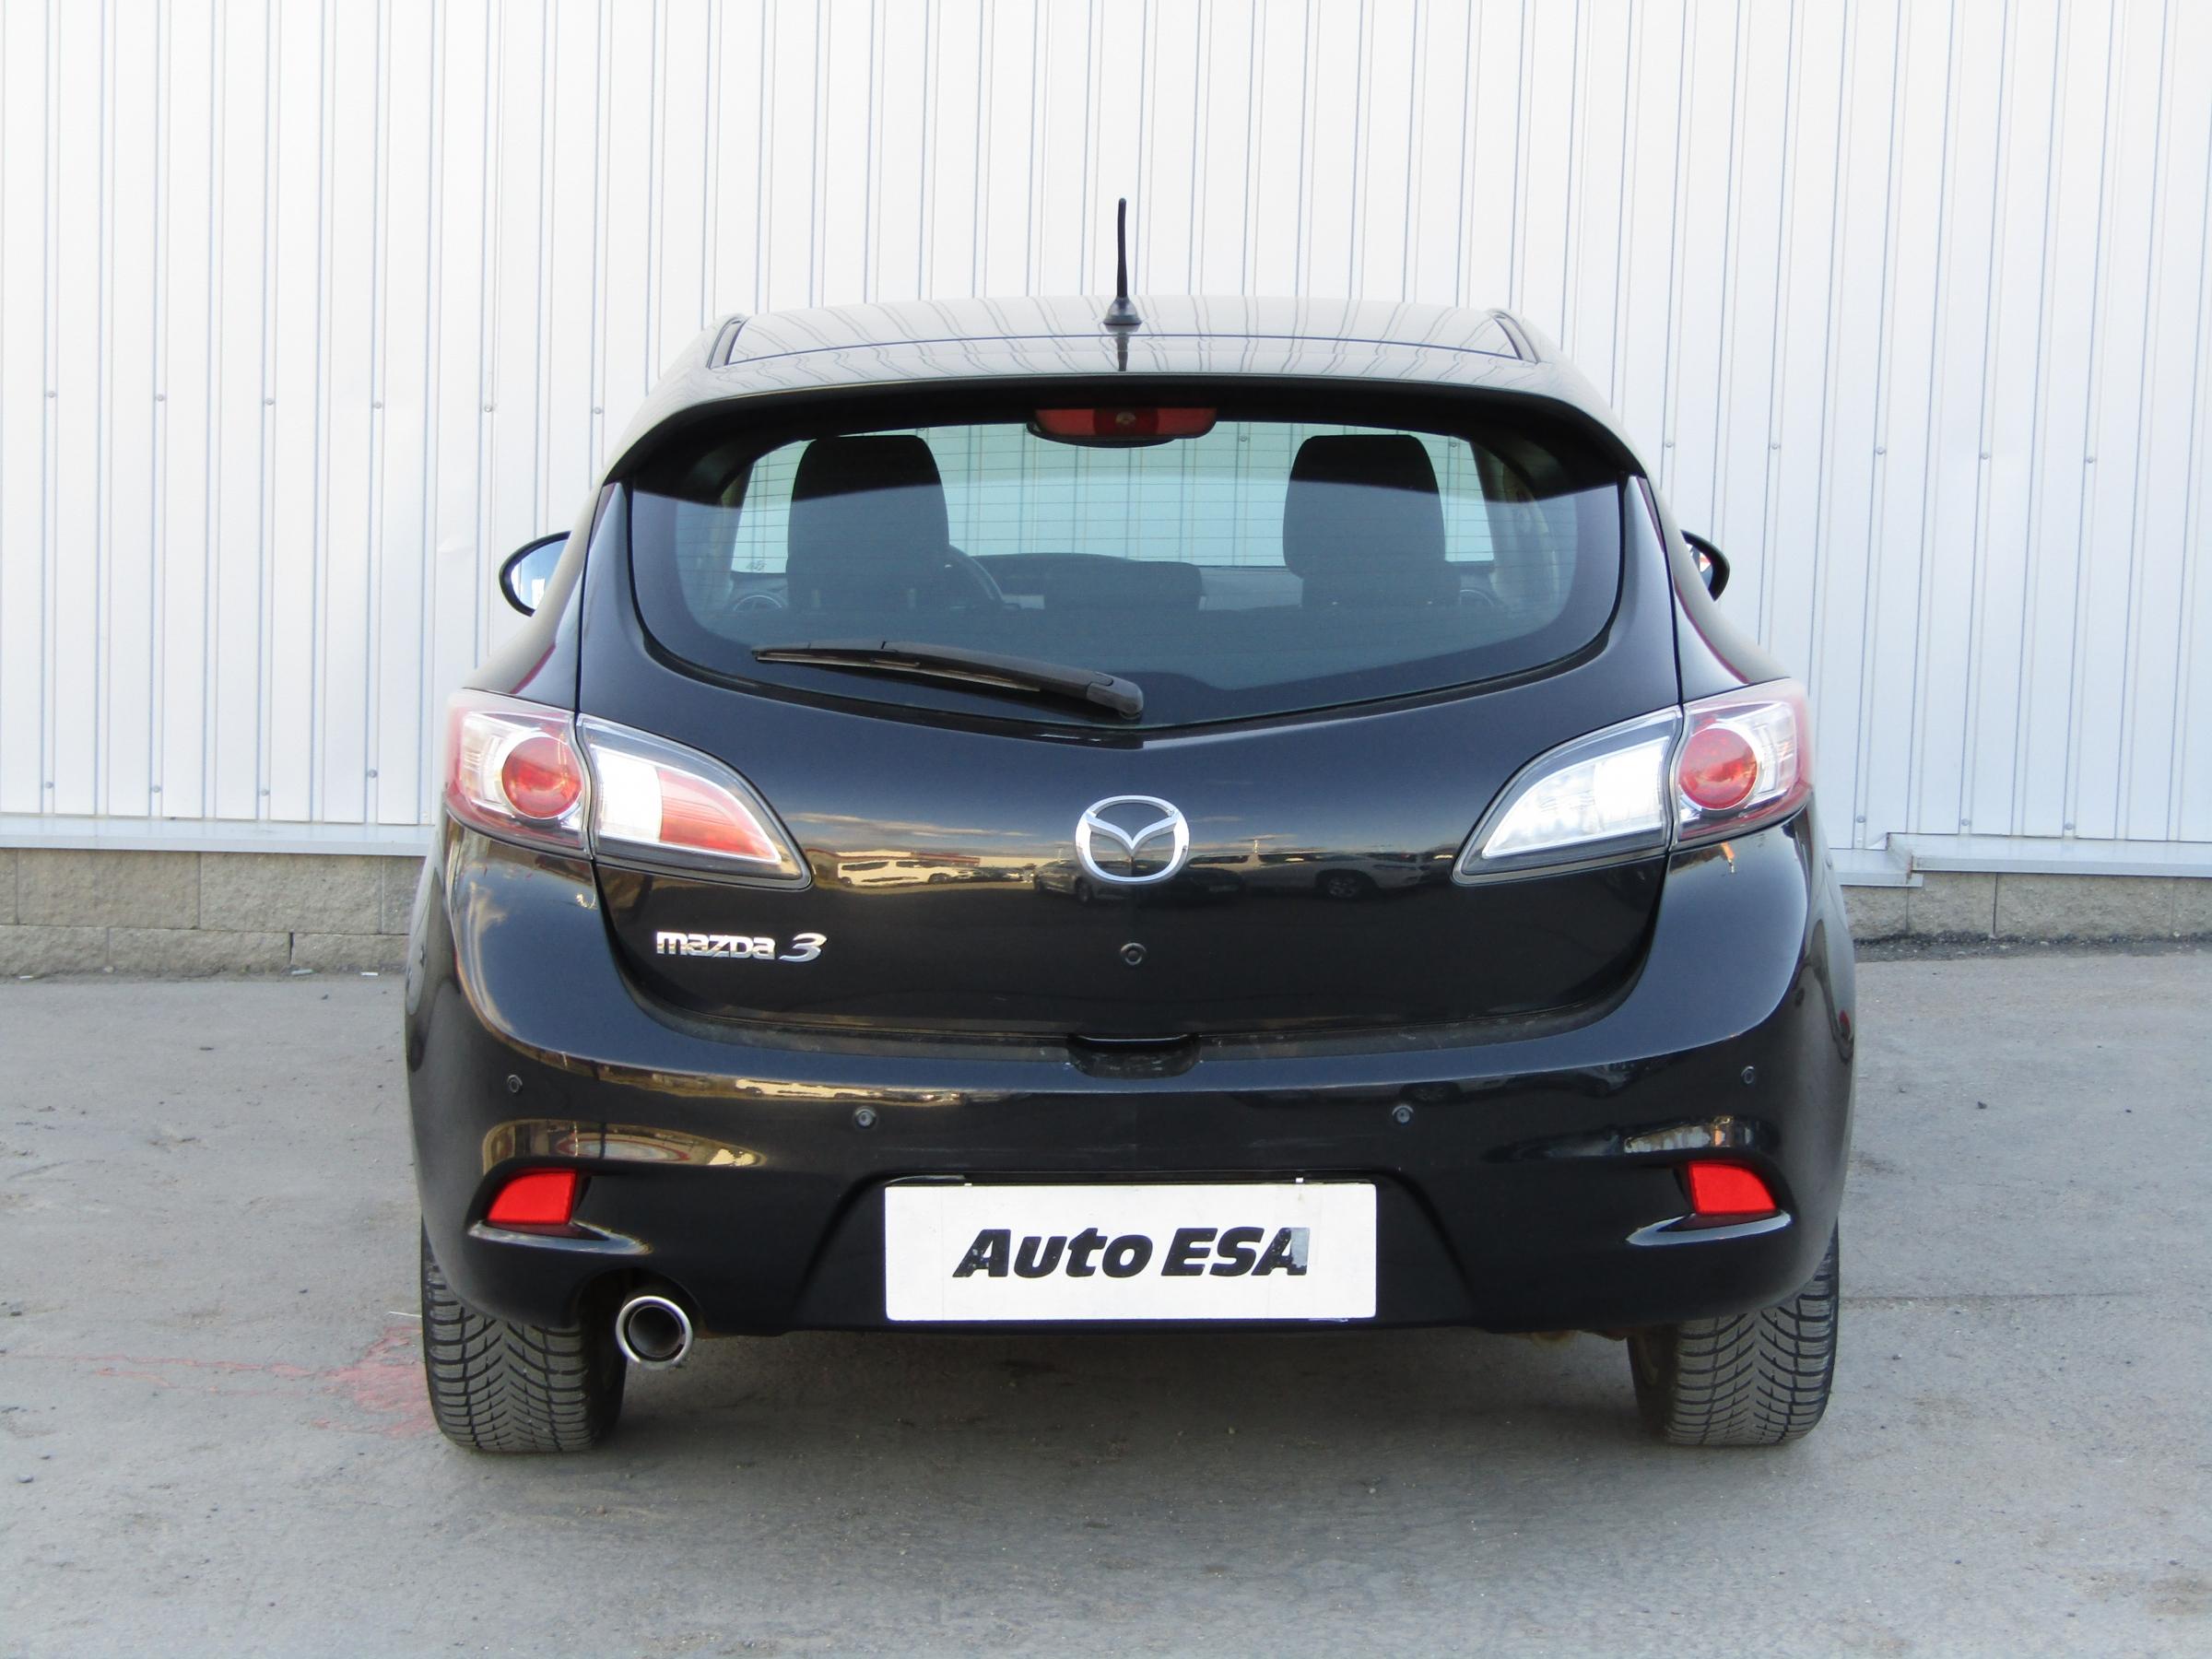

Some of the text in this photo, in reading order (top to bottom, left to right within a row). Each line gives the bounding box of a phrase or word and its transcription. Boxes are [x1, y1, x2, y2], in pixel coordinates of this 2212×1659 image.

[779, 932, 828, 962] 3
[952, 1227, 1310, 1277] Auto ESA
